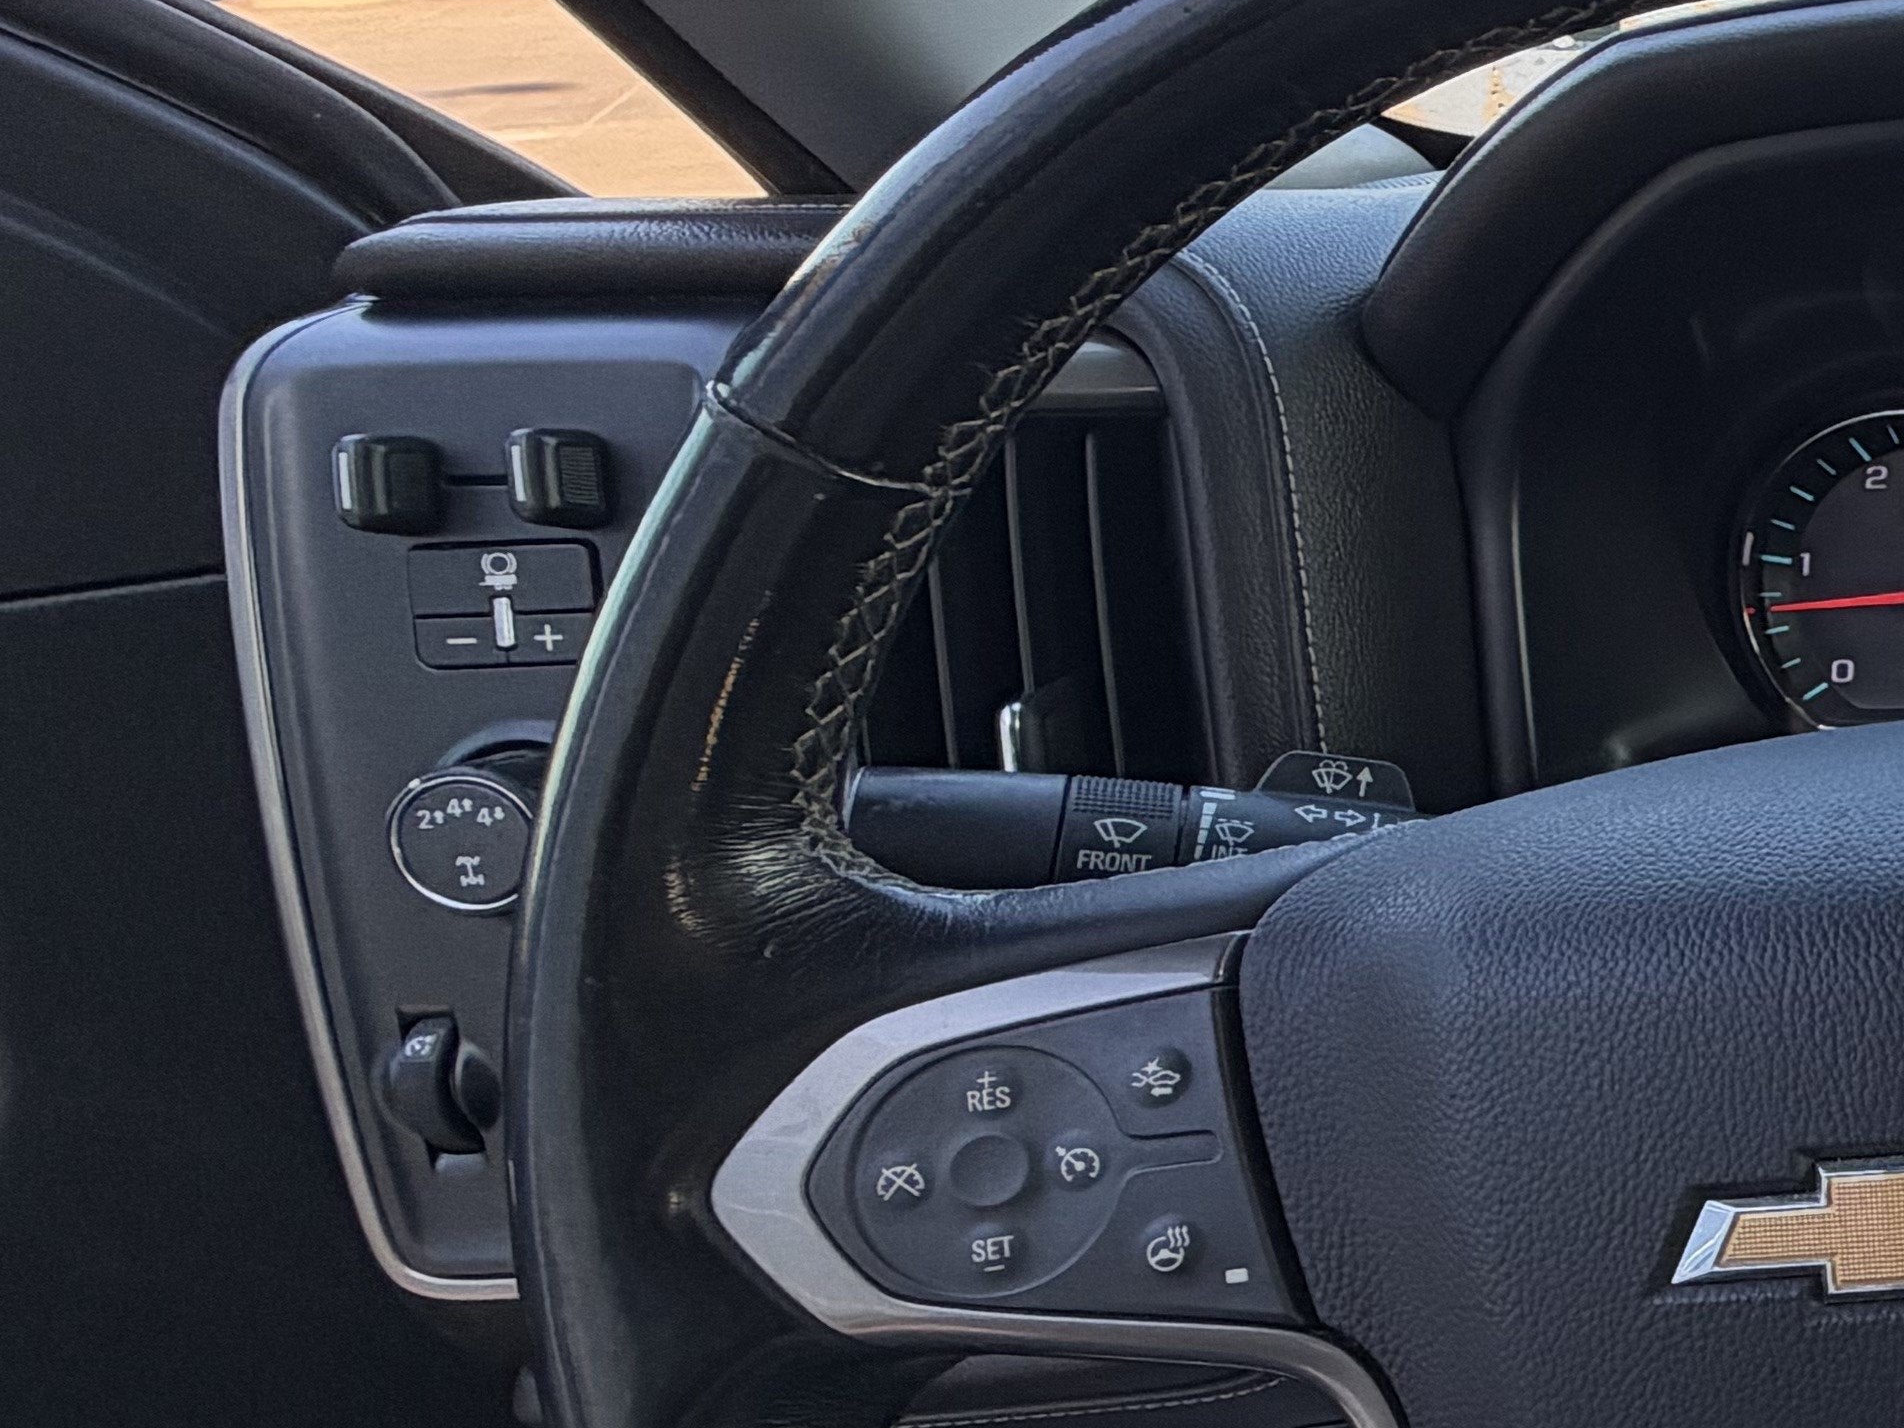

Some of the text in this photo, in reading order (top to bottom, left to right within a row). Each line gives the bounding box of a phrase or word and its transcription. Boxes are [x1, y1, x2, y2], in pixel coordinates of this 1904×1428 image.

[1865, 465, 1889, 489] 2
[1800, 552, 1812, 576] 1
[1831, 659, 1856, 683] 0
[1076, 849, 1152, 874] FRONT
[966, 1085, 1011, 1113] RES
[970, 1235, 1014, 1262] SET
